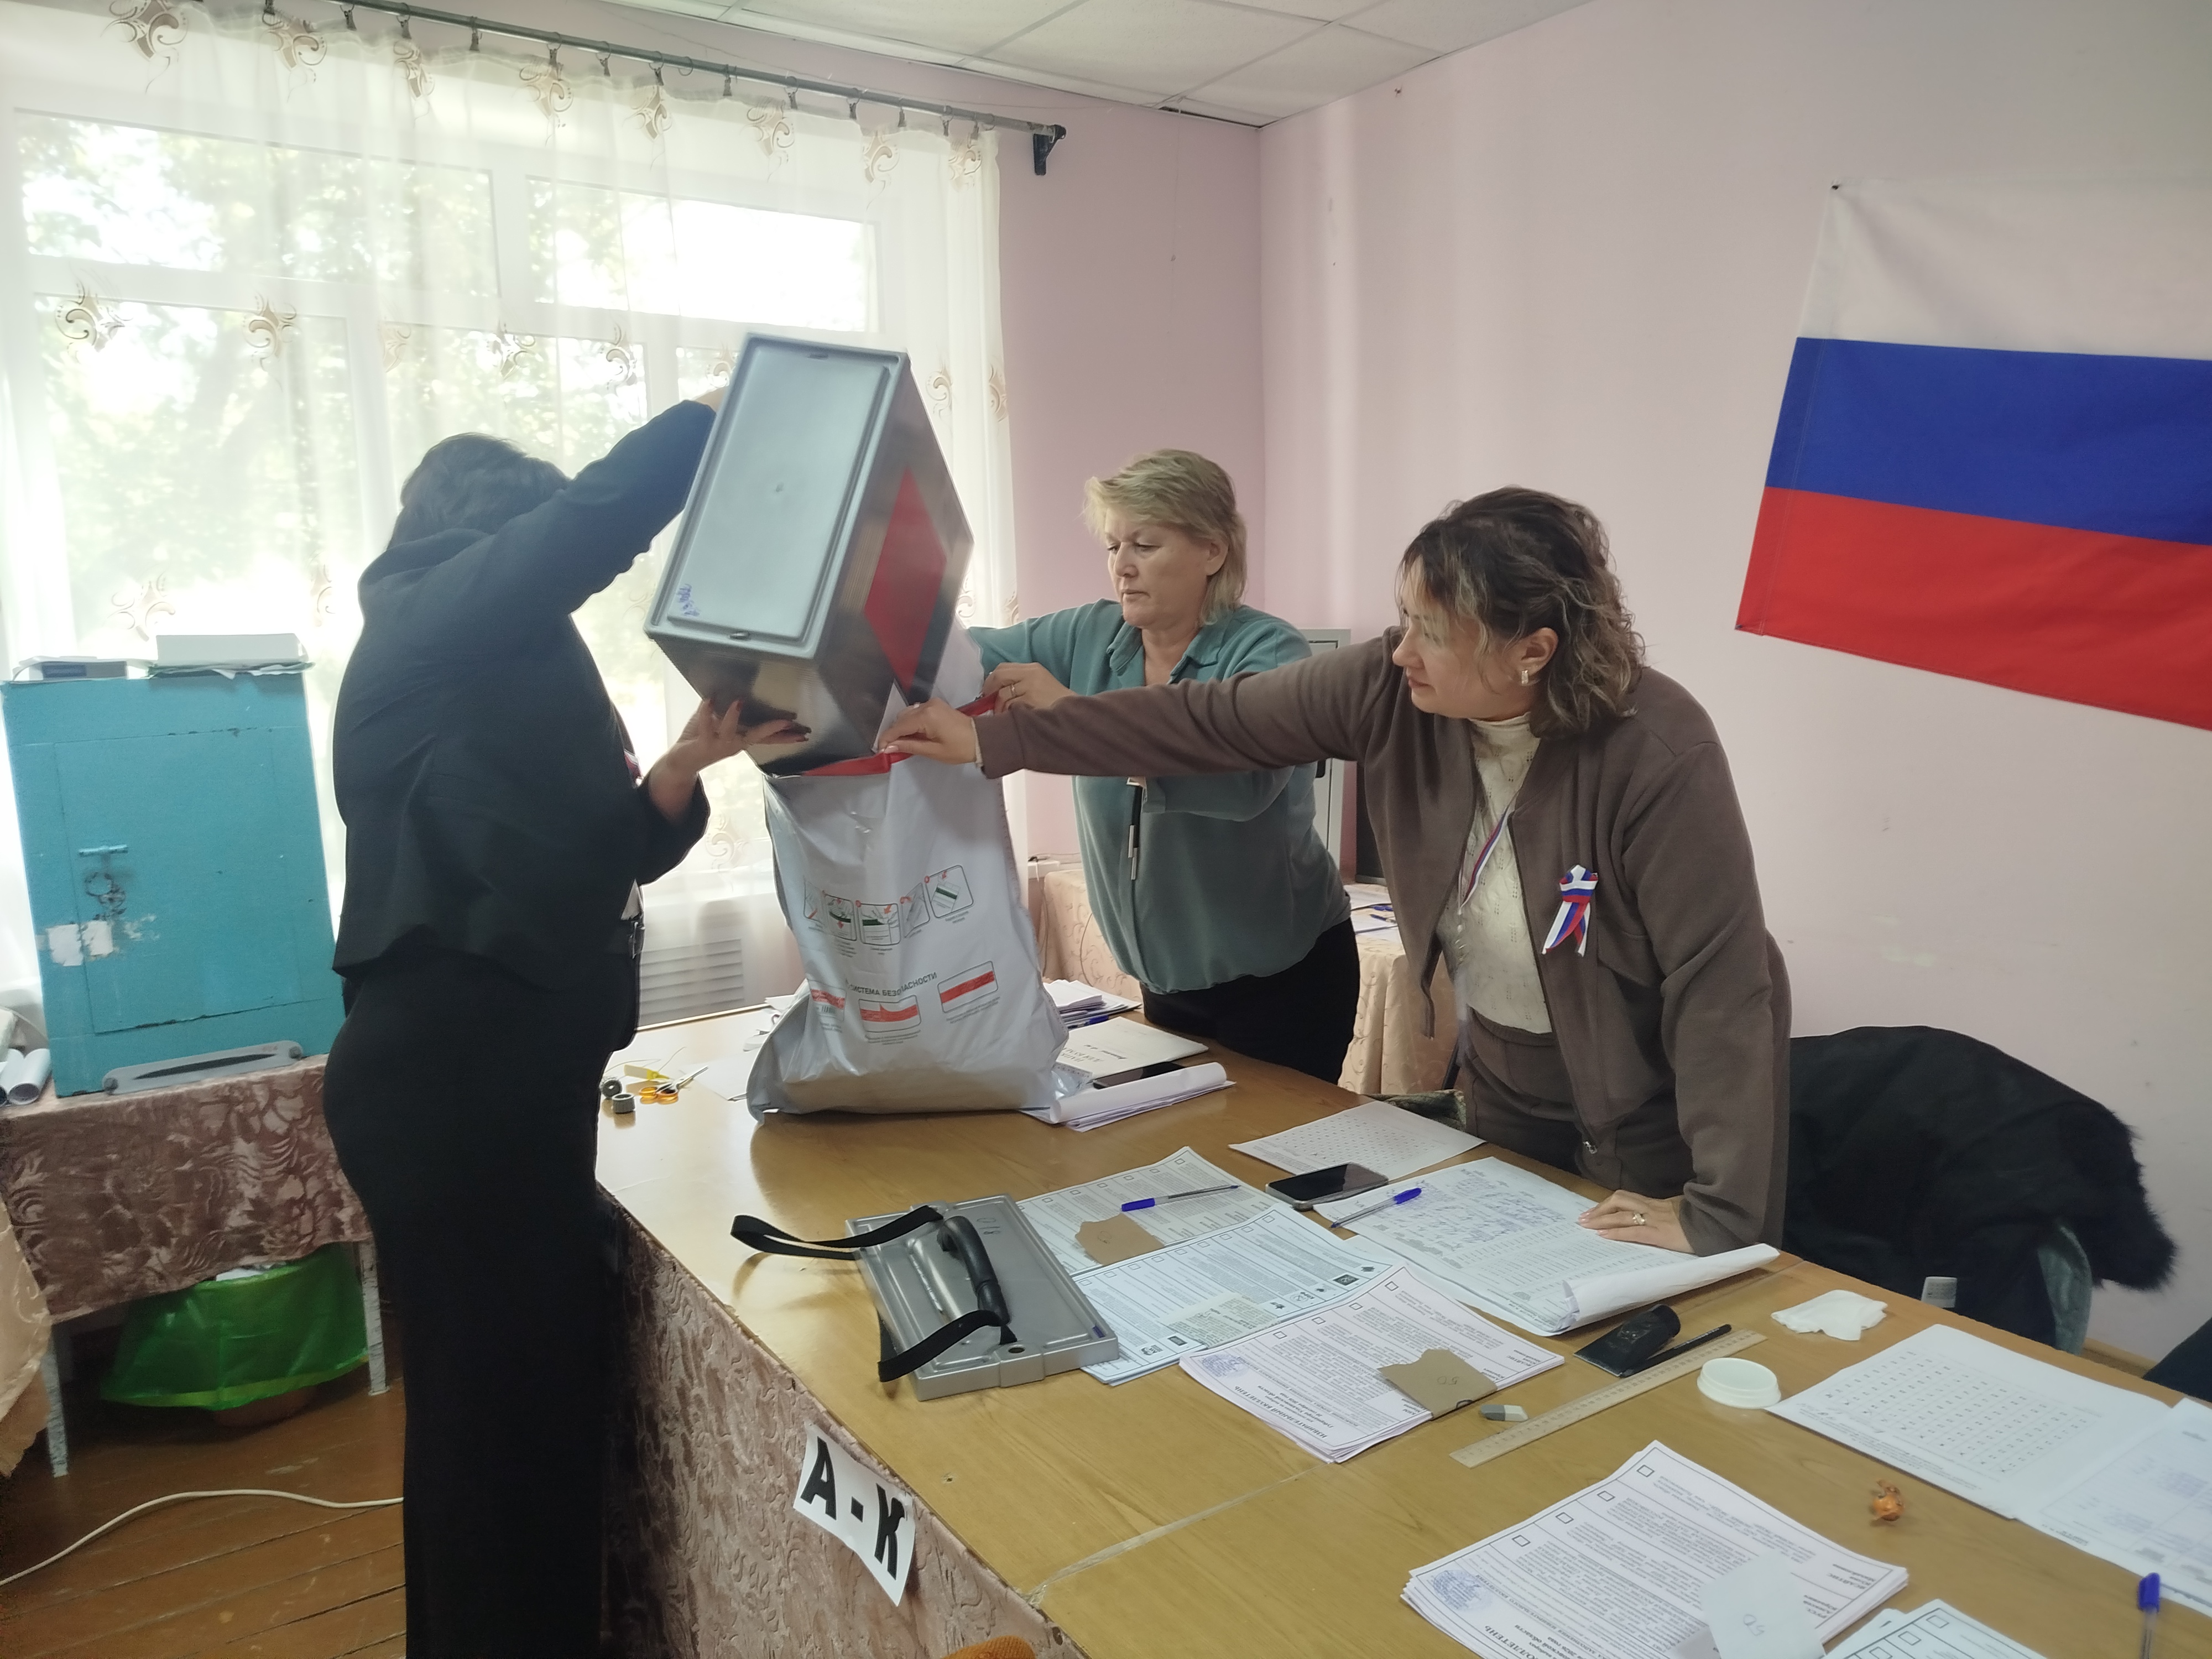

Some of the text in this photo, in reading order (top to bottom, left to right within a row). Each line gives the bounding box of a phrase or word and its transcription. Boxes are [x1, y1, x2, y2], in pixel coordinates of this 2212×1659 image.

[1437, 1376, 1459, 1386] 50
[800, 1436, 905, 1581] А - К
[1515, 1624, 1542, 1644] области
[1743, 1614, 1765, 1637] 50
[1485, 1625, 1539, 1659] ЮЛЛЕТЕНЬ
[1547, 1636, 1577, 1656] 2026 года
